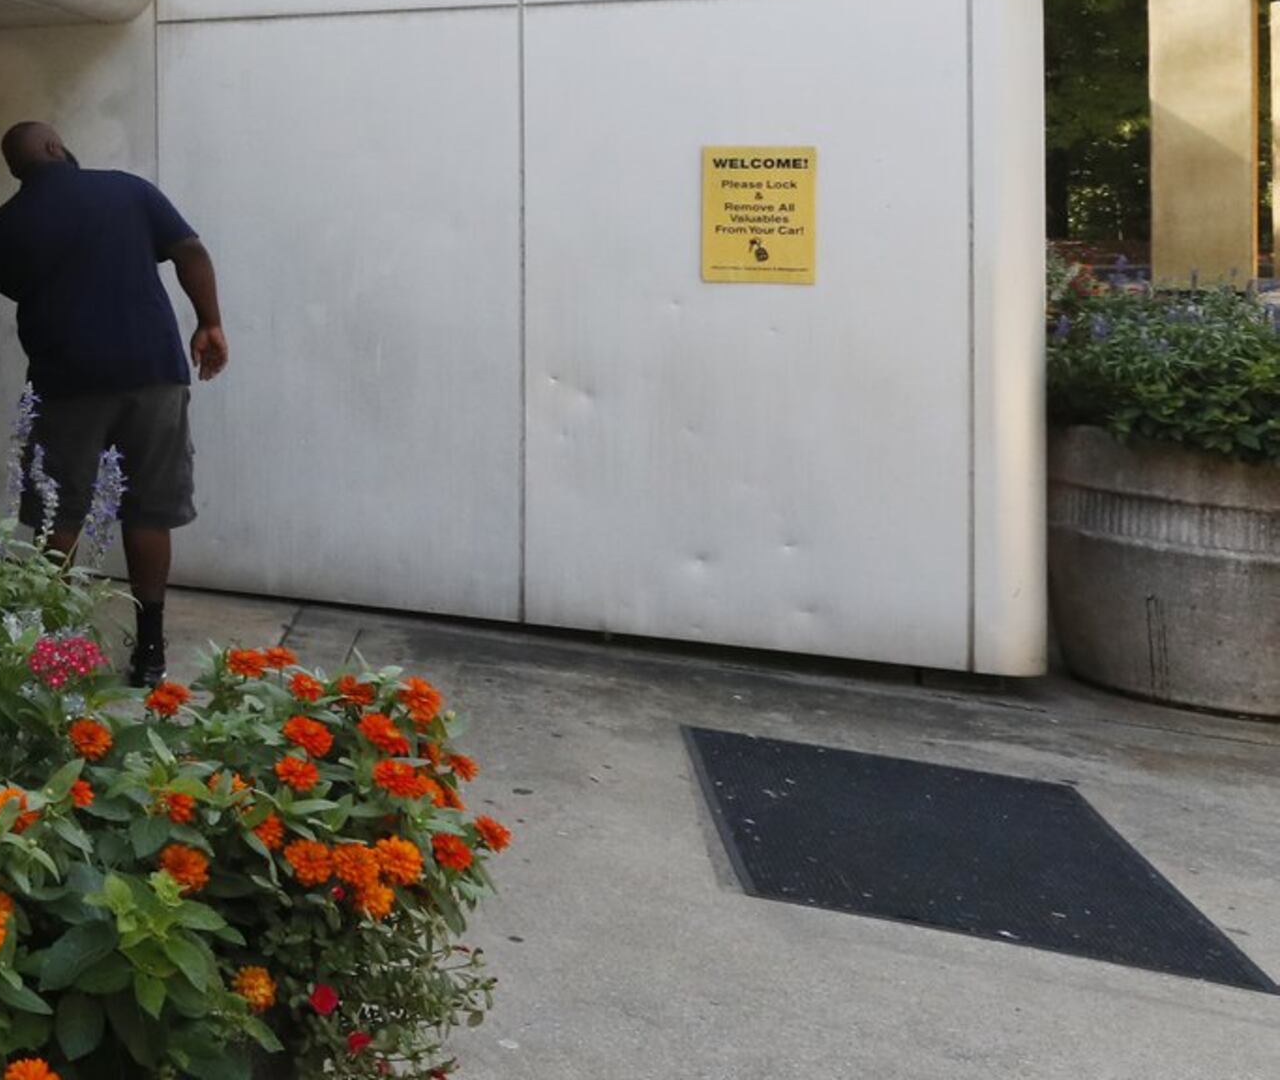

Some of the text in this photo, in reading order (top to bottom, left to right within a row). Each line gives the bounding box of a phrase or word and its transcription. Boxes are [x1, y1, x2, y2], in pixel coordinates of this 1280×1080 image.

[712, 158, 809, 170] WELCOME!
[721, 180, 798, 190] Please Lock
[754, 191, 764, 200] &
[724, 202, 796, 212] Remove All
[730, 214, 790, 224] Valuables
[715, 225, 805, 236] From Your Car!
